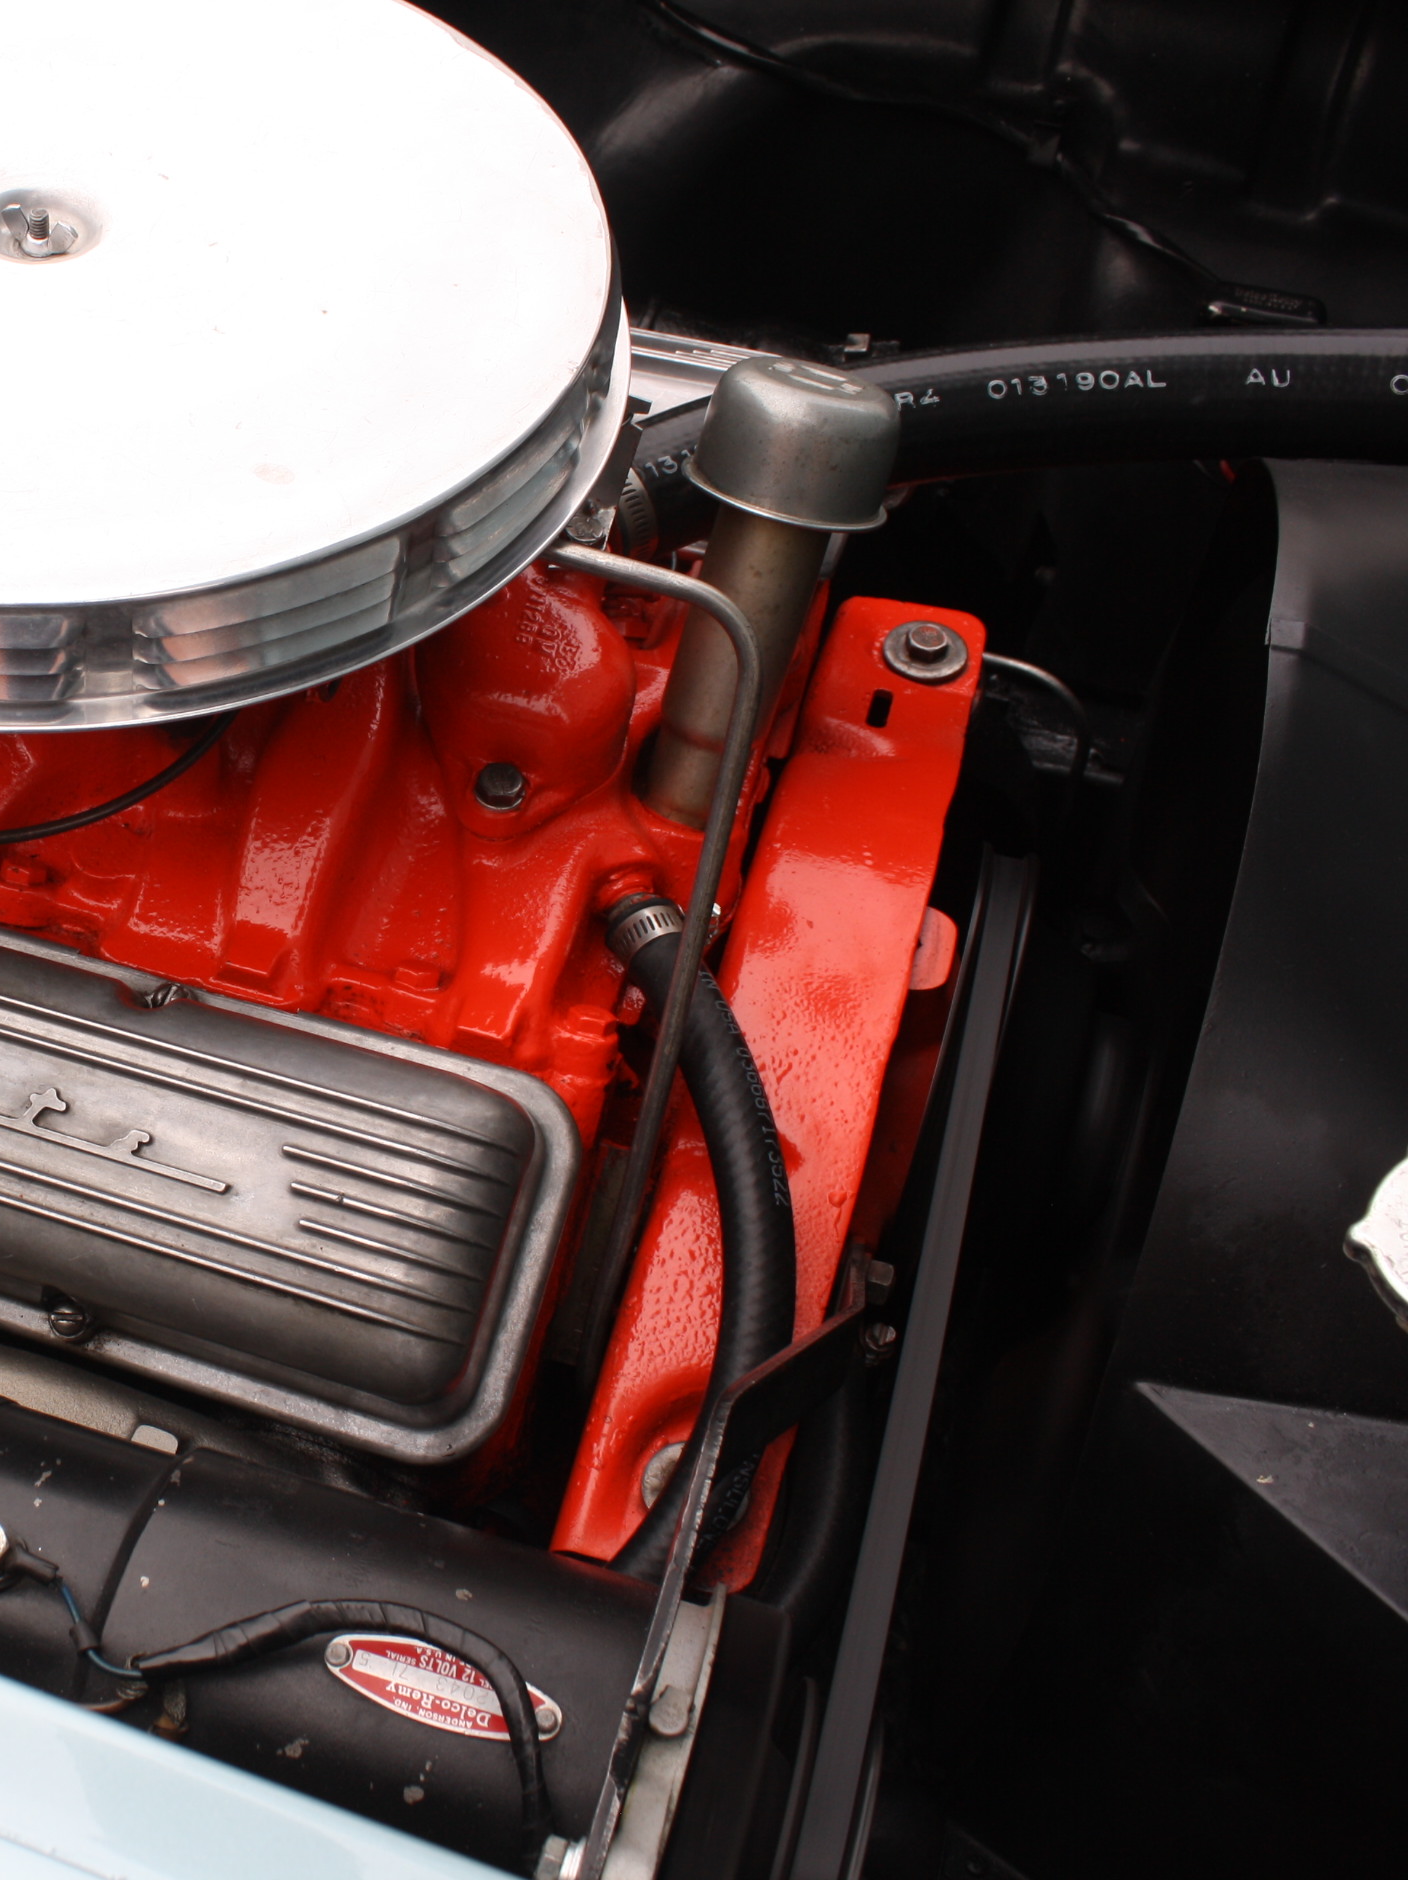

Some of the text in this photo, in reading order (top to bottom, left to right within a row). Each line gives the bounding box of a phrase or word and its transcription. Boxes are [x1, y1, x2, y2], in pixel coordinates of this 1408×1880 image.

[1245, 368, 1290, 388] AU
[386, 1650, 416, 1666] SERIAL
[419, 1655, 457, 1679] VOLTS
[461, 1668, 476, 1683] 12
[386, 1682, 491, 1727] Delco-Remy
[392, 1696, 473, 1728] ANDERSON, IND.
